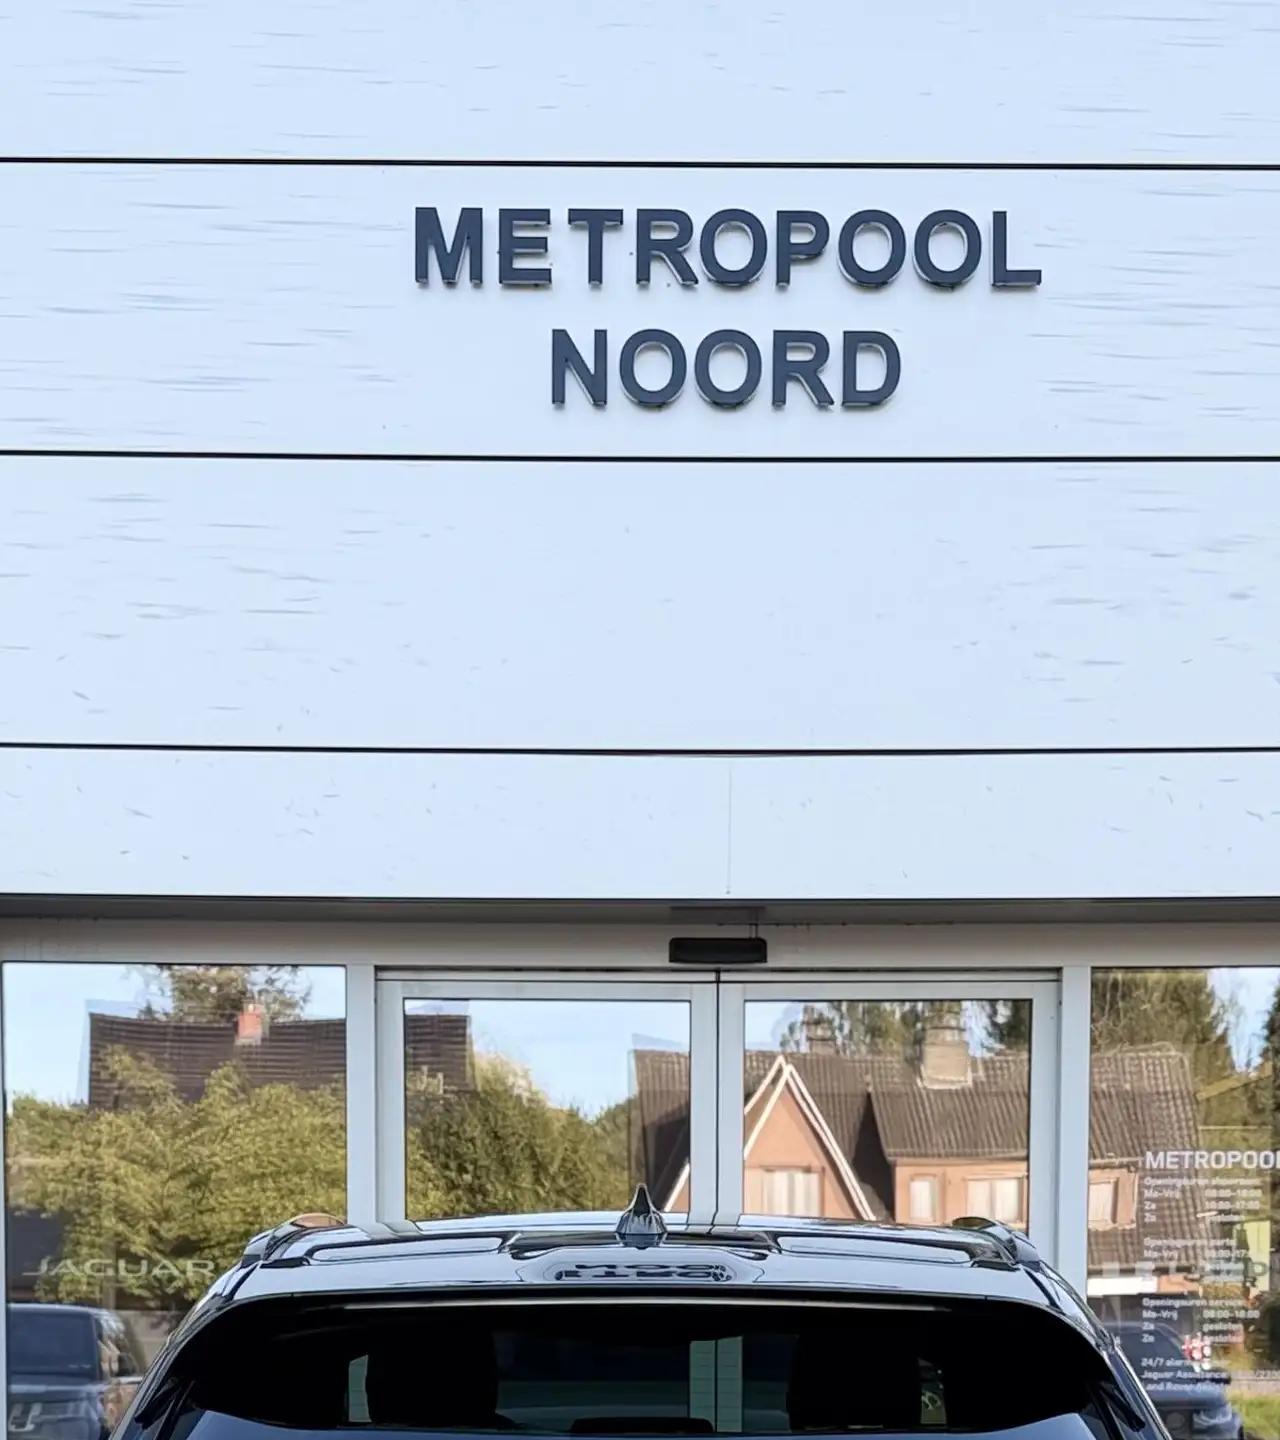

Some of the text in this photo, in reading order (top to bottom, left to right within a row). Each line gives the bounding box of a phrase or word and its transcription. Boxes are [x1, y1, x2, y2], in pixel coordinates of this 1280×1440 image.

[414, 207, 1042, 287] METROPOOL
[551, 328, 902, 408] NOORD
[22, 1256, 216, 1278] JAGUAR
